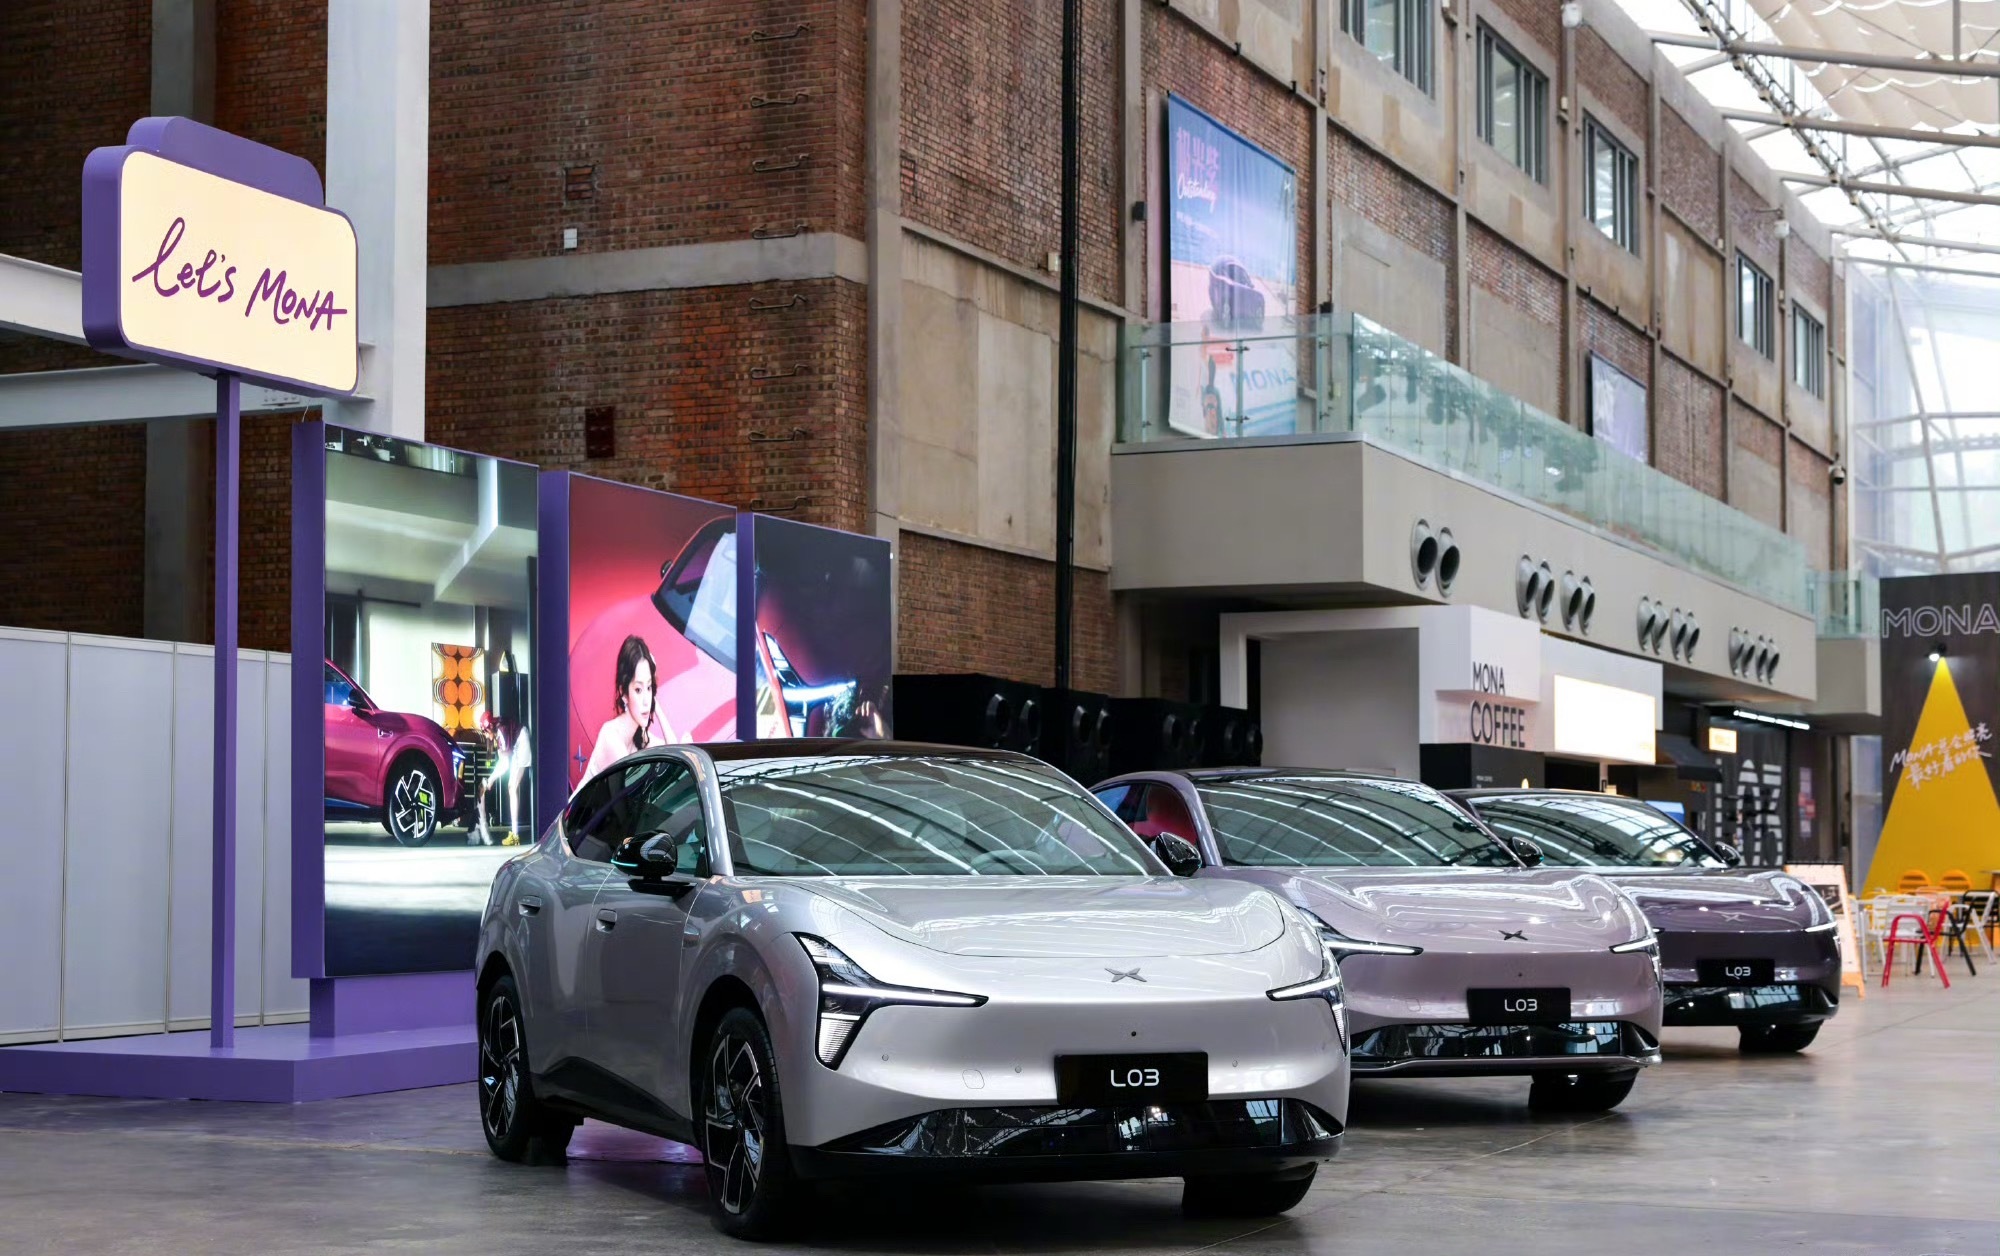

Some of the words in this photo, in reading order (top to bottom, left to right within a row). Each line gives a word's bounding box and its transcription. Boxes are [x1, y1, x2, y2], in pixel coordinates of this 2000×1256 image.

[1882, 603, 2000, 639] MONA
[1473, 661, 1506, 696] MONA
[1471, 700, 1525, 748] COFFEE
